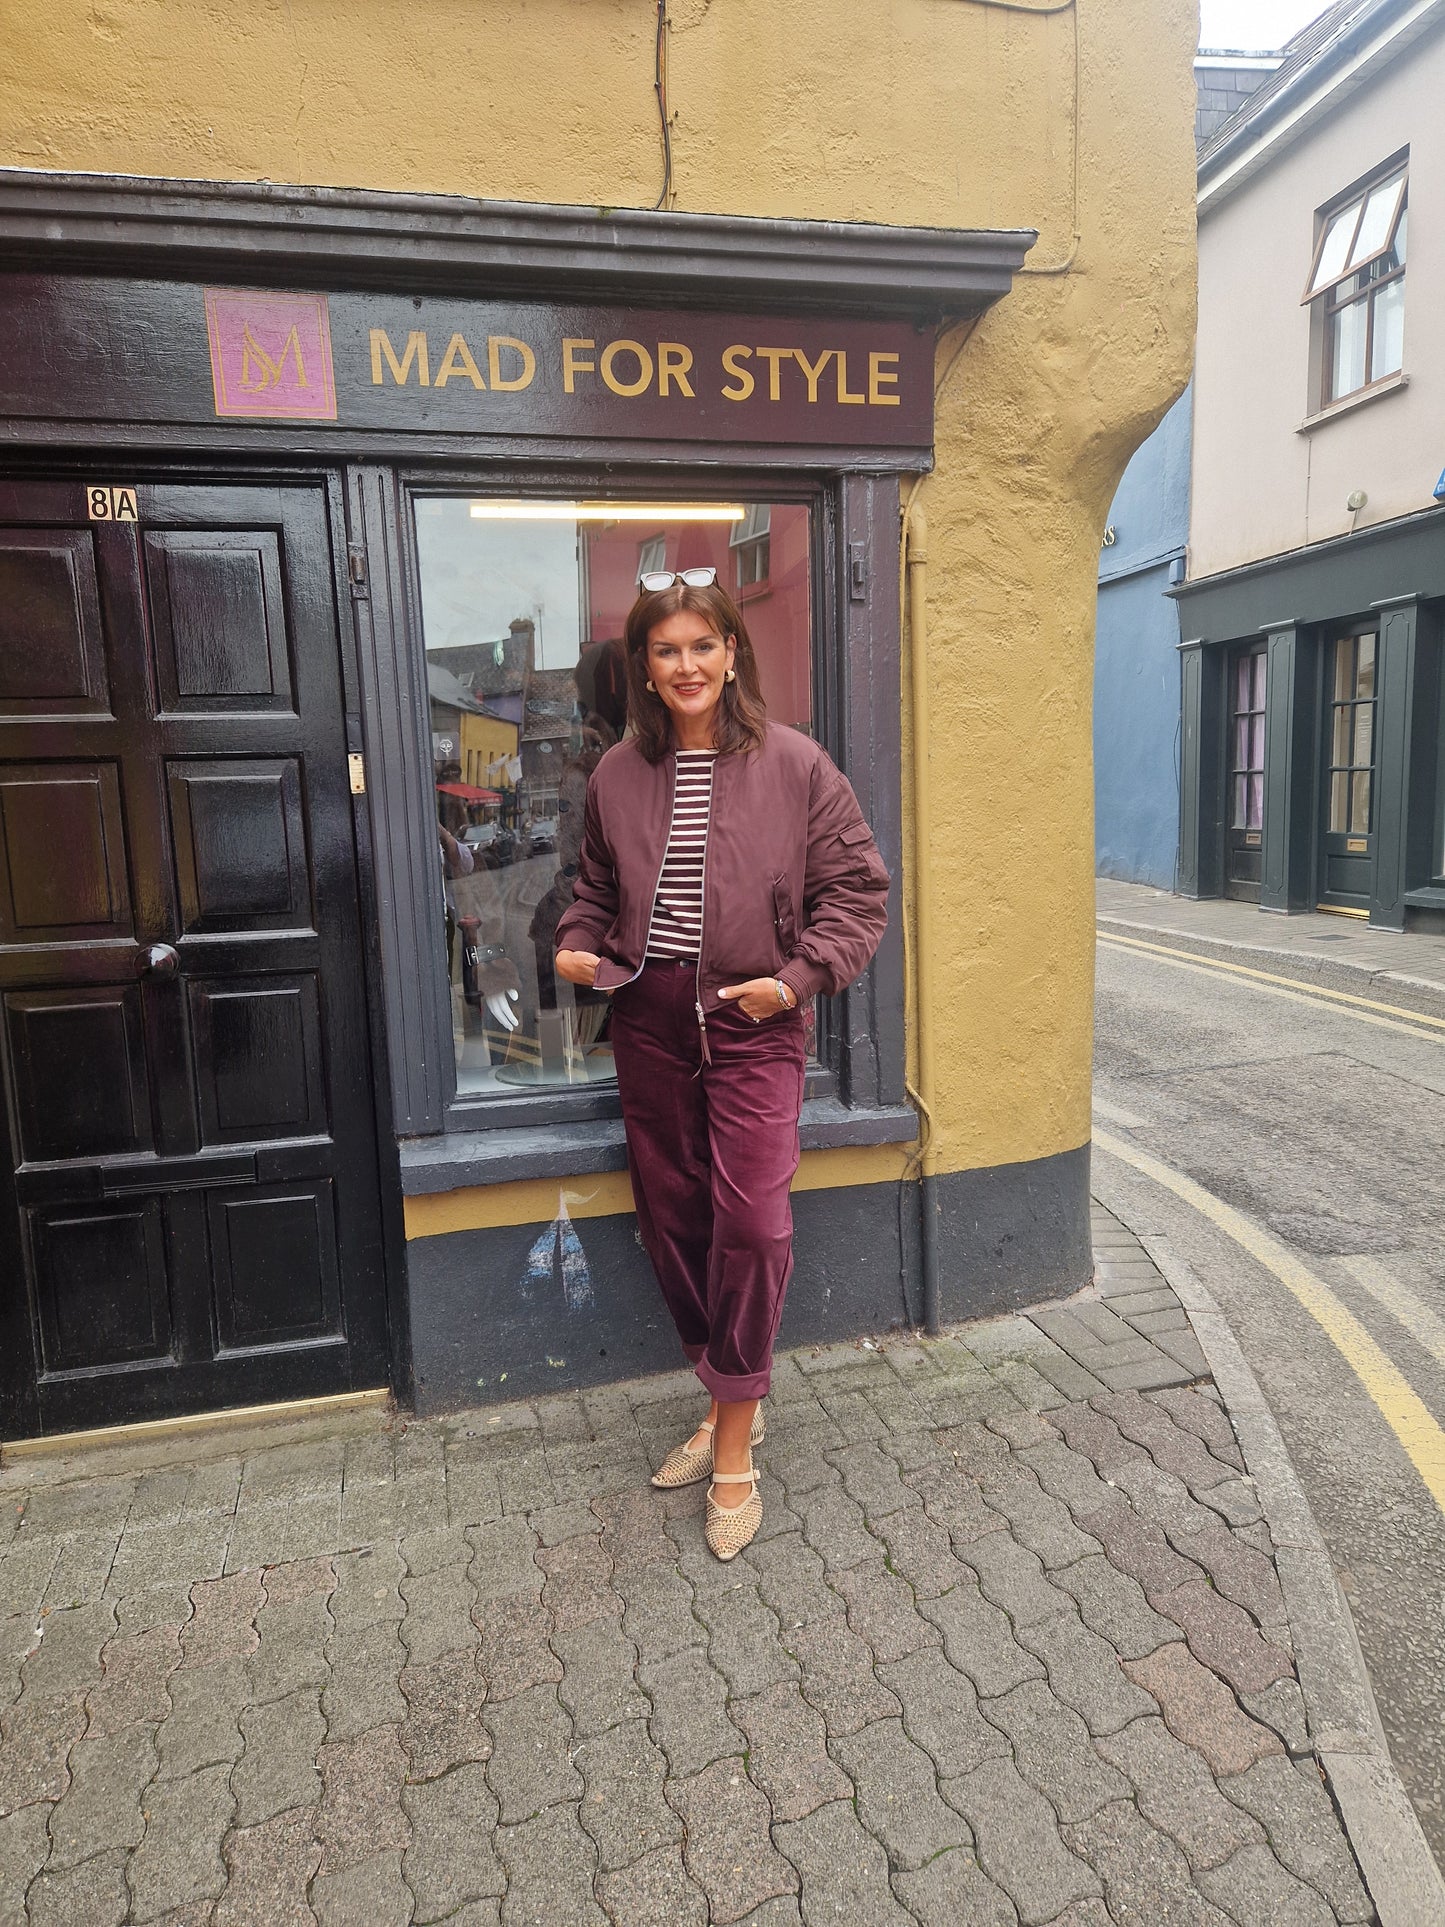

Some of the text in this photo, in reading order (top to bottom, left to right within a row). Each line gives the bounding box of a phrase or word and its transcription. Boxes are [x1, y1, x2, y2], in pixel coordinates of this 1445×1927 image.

[369, 328, 901, 405] MAD FOR STYLE
[91, 488, 137, 519] 8A
